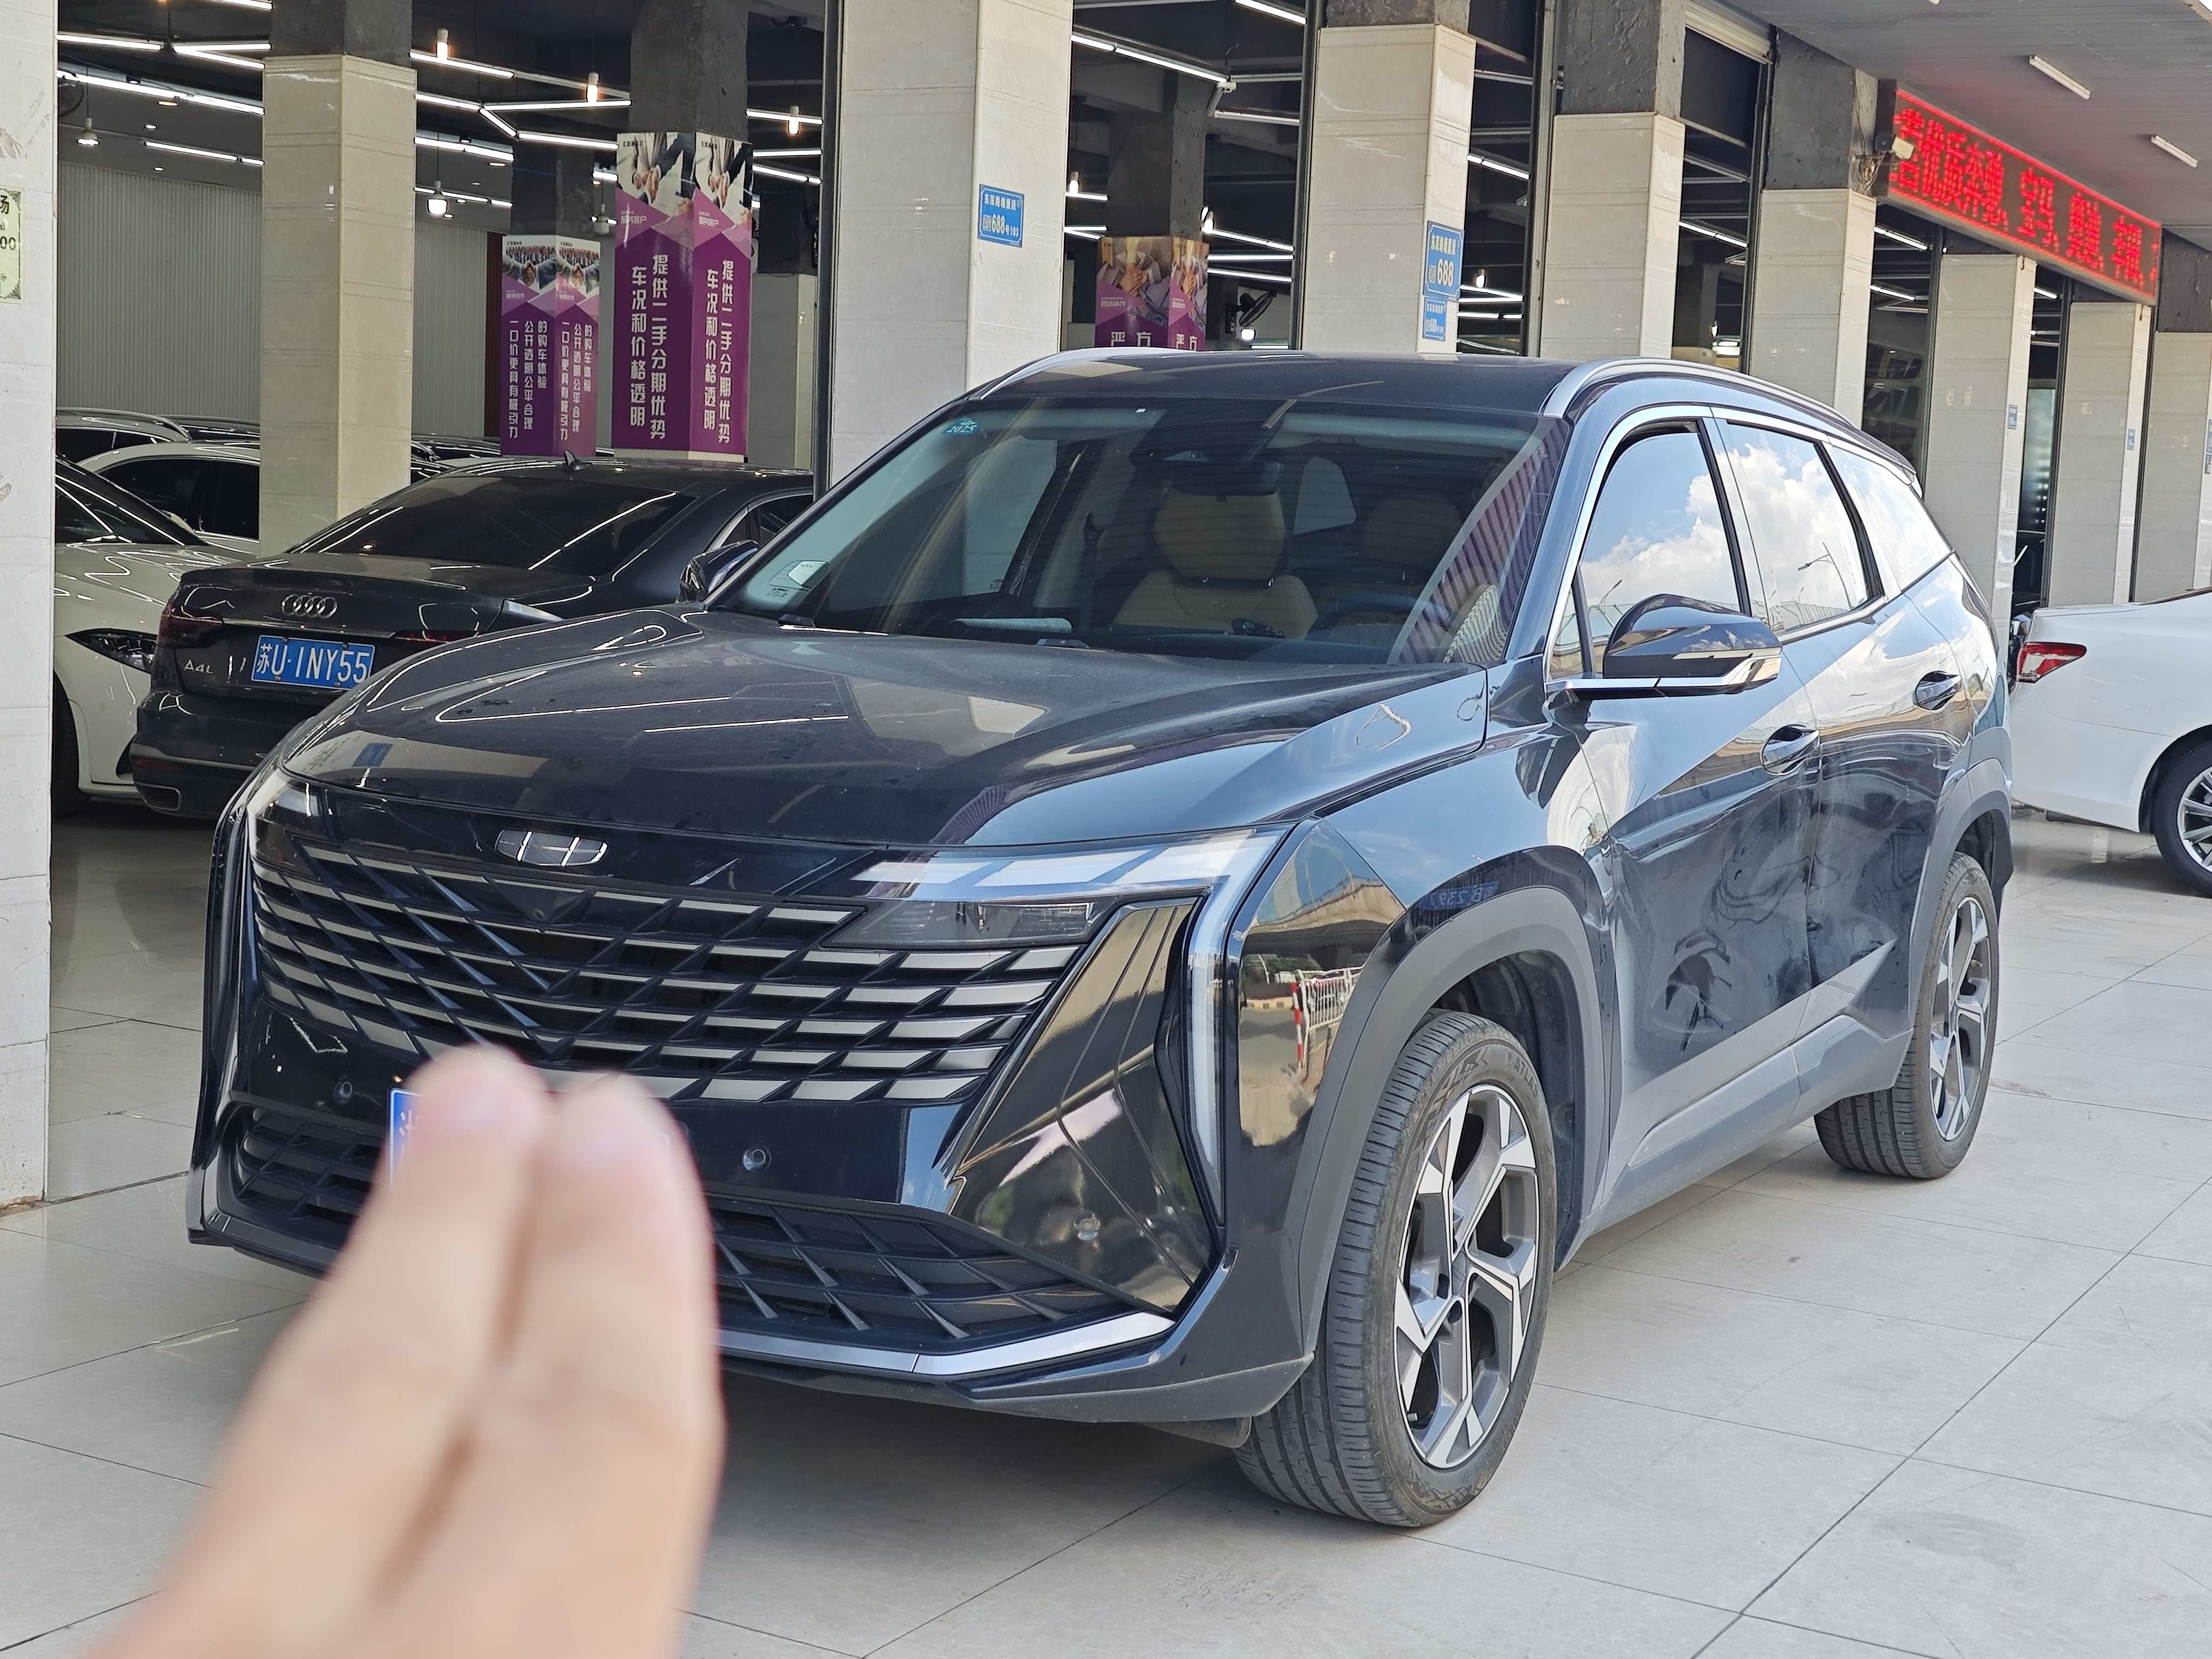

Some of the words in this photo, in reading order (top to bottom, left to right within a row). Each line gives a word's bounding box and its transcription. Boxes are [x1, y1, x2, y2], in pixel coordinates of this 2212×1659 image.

[1437, 258, 1454, 287] 688
[508, 320, 519, 439] 一口价更具有吸引力
[523, 320, 534, 430] 公开透明公平合理
[537, 320, 548, 389] 的购车体验
[560, 321, 570, 441] 一口价更具有吸引力
[572, 323, 582, 432] 公开透明公平合理
[583, 324, 592, 392] 的购车体验
[630, 266, 647, 427] 车况和价格透明
[650, 254, 668, 440] 提供二手分期优势
[704, 269, 719, 430] 车况和价格透明
[718, 259, 734, 444] 提供二手分期优势
[184, 659, 213, 675] A4L
